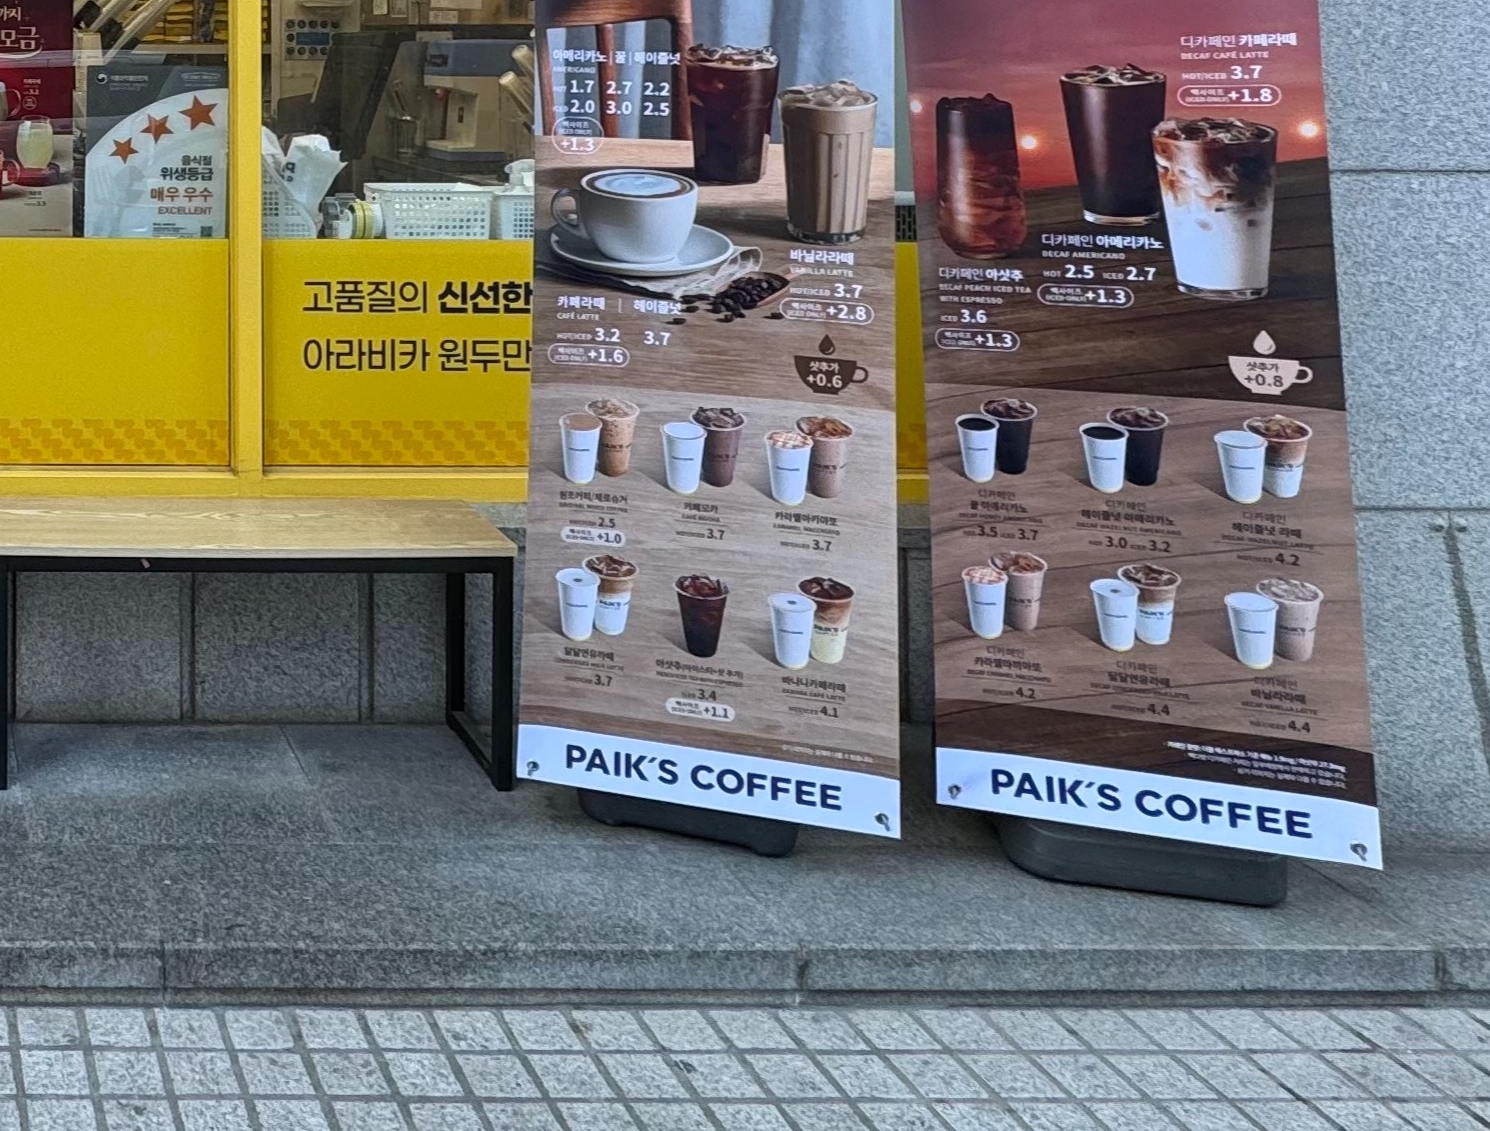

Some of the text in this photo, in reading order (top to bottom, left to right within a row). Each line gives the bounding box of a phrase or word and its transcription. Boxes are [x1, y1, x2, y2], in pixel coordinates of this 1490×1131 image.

[1180, 33, 1298, 48] 디카페인 카페라떼
[553, 50, 608, 63] 아메리카노
[634, 52, 681, 65] 헤이즐넛
[1180, 52, 1211, 60] DECAF
[1239, 51, 1269, 59] LATTE
[1230, 65, 1262, 79] 3.7
[570, 80, 670, 96] 1.7 2.7 2.2
[1228, 88, 1273, 102] +1.8
[570, 100, 670, 116] 2.0 3.0 2.5
[561, 138, 595, 151] +1.3
[181, 155, 213, 166] 음식점
[160, 167, 213, 181] 위생등급
[150, 187, 213, 202] 매우 우수
[158, 206, 212, 215] EXCELLENT
[1042, 234, 1164, 249] 디카페인 아메리카노
[790, 249, 854, 265] 바닐라라떼
[939, 267, 1024, 281] 디카페인 아샷추
[1065, 264, 1095, 279] 2.5
[1126, 266, 1156, 281] 2.7
[302, 280, 532, 314] 고품질의 신선한
[834, 283, 863, 299] 3.7
[1015, 286, 1032, 294] TEA
[1085, 289, 1126, 304] +1.3
[557, 296, 681, 315] 카페라떼 헤이즐넛
[826, 305, 866, 320] +2.8
[960, 309, 987, 323] 3.6
[595, 328, 671, 345] 3.2 3.7
[975, 333, 1013, 348] +1.3
[304, 339, 531, 372] 아라비카 원두만
[588, 348, 624, 363] +1.6
[810, 360, 840, 373] 샷추가
[1246, 360, 1280, 372] 샷추가
[806, 375, 843, 388] +0.6
[1243, 373, 1284, 389] +0.8
[598, 517, 616, 528] 2.5
[597, 532, 622, 544] +1.0
[706, 529, 725, 540] 3.7
[977, 525, 1039, 541] 3.5 3.7
[812, 539, 832, 551] 3.7
[1105, 536, 1171, 553] 3.0 3.2
[1275, 552, 1300, 566] 4.2
[594, 675, 612, 686] 3.7
[697, 689, 717, 701] 3.4
[1015, 687, 1036, 699] 4.2
[704, 706, 729, 719] +1.1
[820, 706, 839, 718] 4.1
[1147, 704, 1171, 716] 4.4
[1288, 720, 1311, 733] 4.4
[565, 744, 843, 811] PAIK'S COFFEE
[991, 768, 1313, 839] PAIK'S COFFEE
